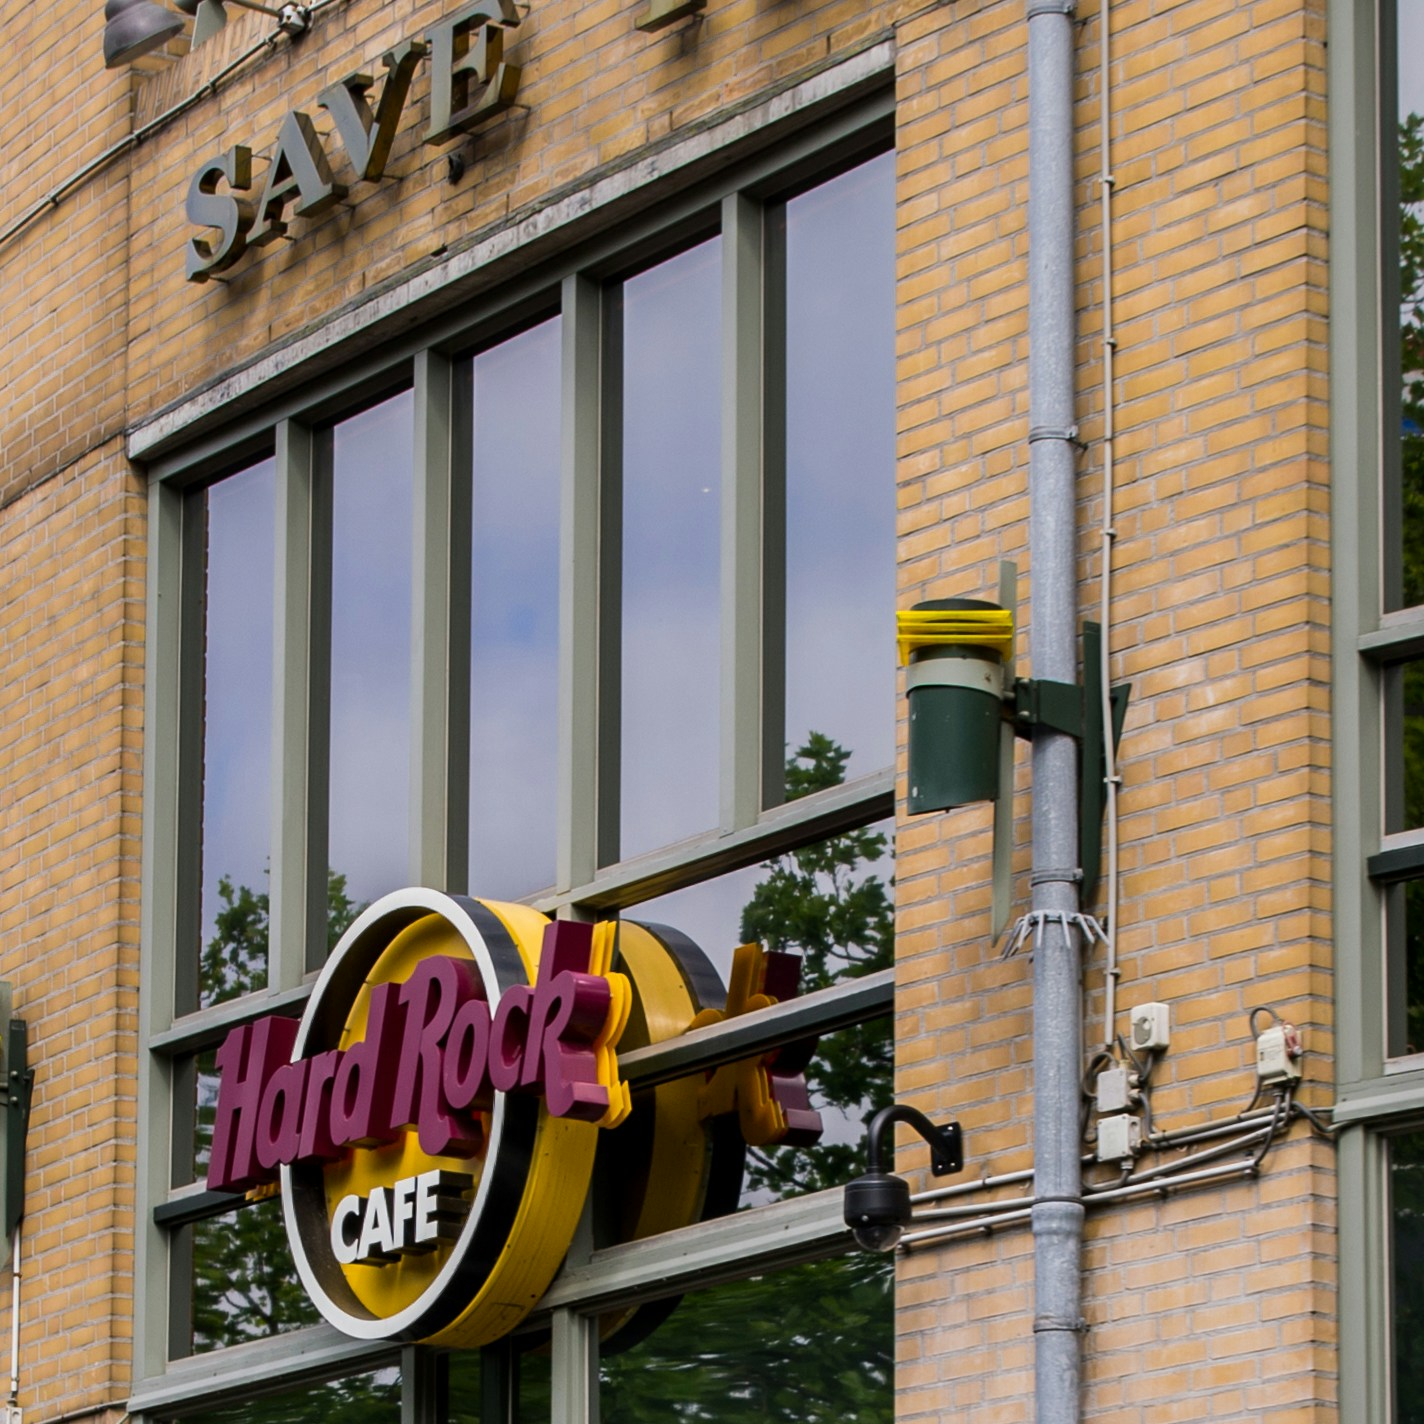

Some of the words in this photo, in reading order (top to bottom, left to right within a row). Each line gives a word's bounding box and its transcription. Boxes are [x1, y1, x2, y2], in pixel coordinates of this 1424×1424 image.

[185, 0, 521, 282] SAVE
[207, 981, 400, 1193] Hard
[391, 919, 610, 1158] Rock
[331, 1169, 448, 1265] CAFE
